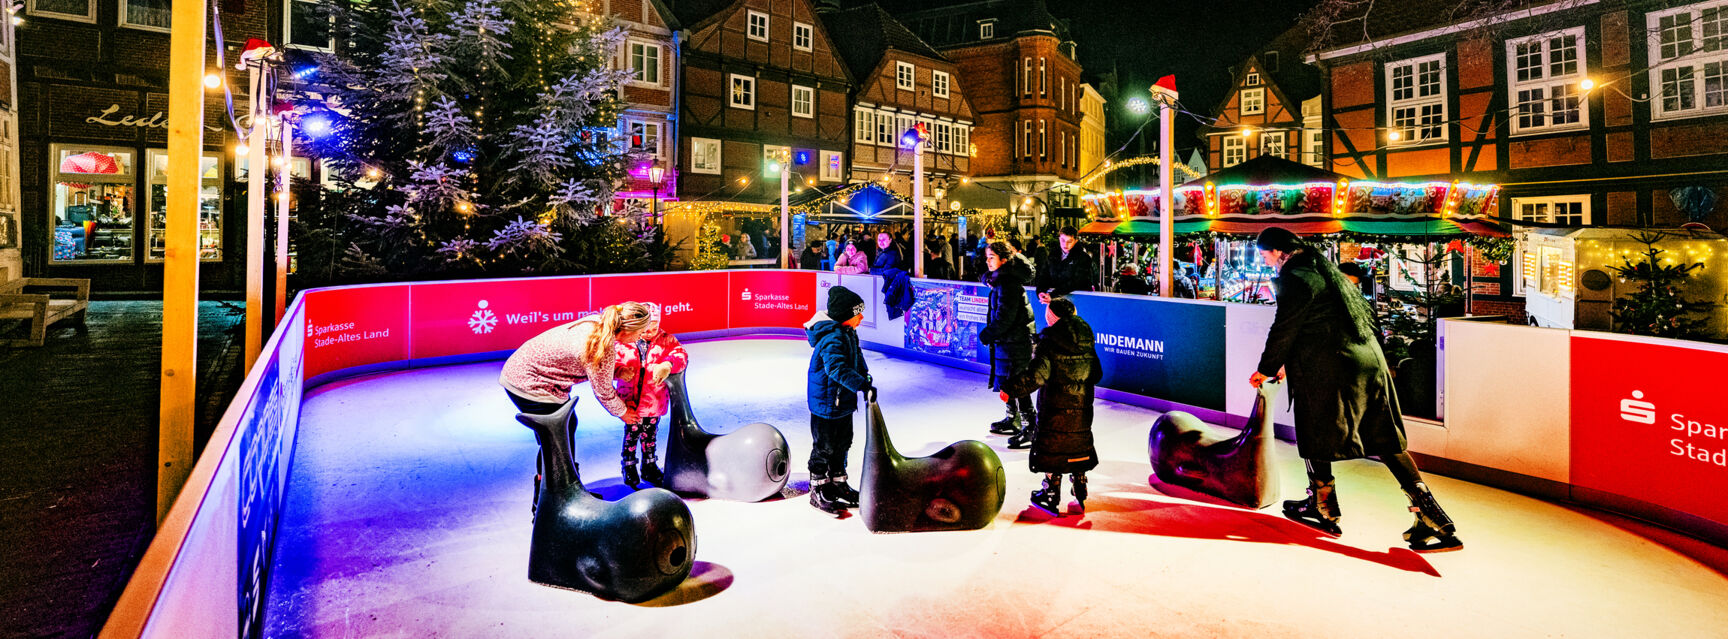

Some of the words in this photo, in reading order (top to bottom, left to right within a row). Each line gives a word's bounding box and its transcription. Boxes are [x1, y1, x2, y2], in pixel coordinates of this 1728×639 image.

[754, 293, 790, 302] Sparkasse
[506, 311, 549, 325] Weil's
[553, 312, 574, 321] um
[665, 302, 693, 316] geht.
[754, 302, 793, 310] Stade-Altes
[794, 303, 809, 311] Land
[314, 322, 355, 336] Sparkasse
[314, 333, 361, 349] Stade-Altes
[363, 328, 390, 340] Land
[1094, 332, 1164, 353] INDEMANN
[1116, 348, 1135, 356] BAUEN
[1136, 351, 1164, 361] ZUKUNFT
[1670, 413, 1728, 440] Spar
